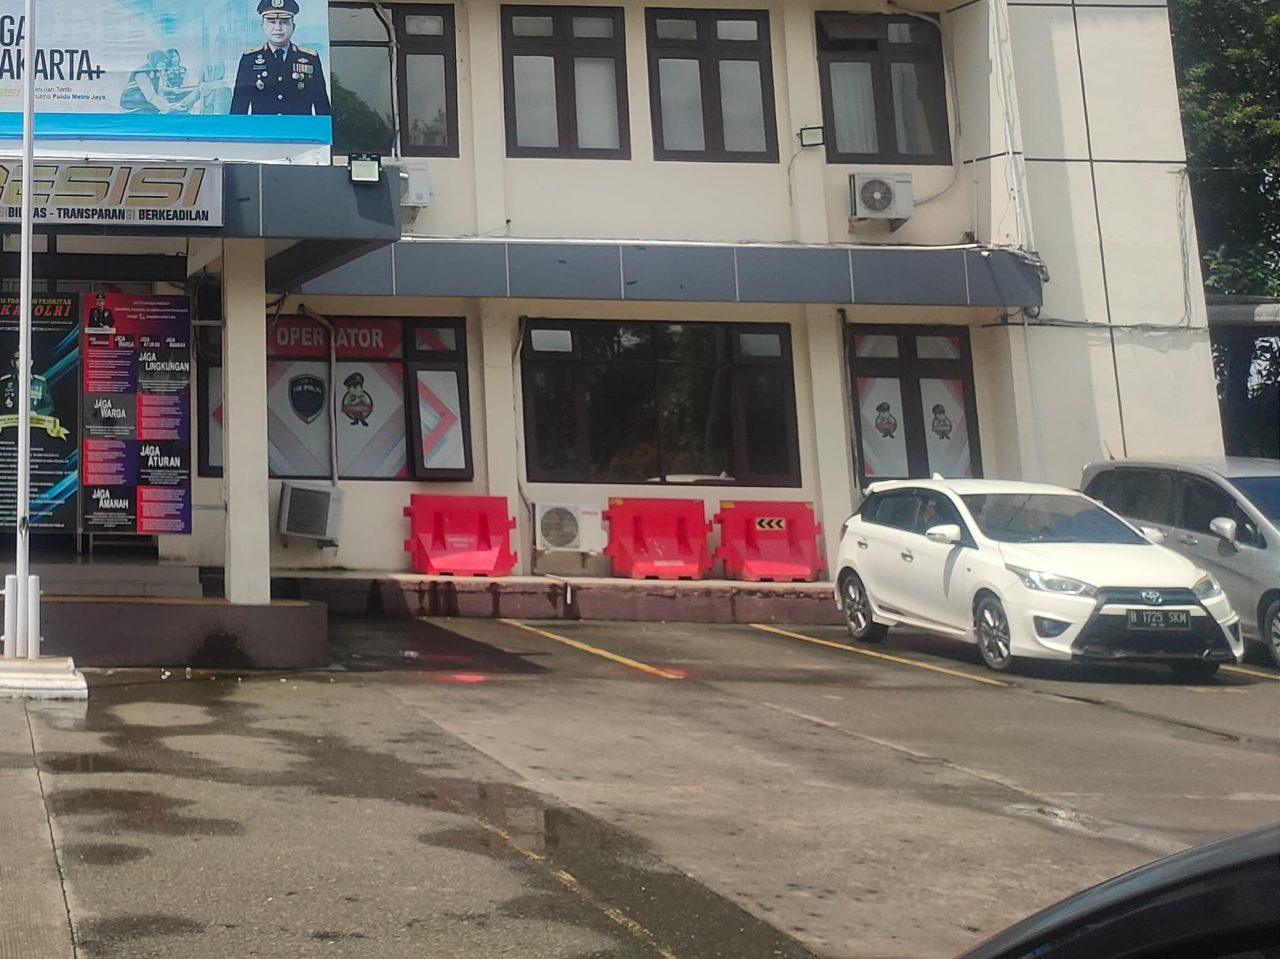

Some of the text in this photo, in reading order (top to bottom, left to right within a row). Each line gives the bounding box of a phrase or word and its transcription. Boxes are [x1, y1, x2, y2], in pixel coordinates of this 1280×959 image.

[91, 93, 106, 101] Jaya
[57, 207, 135, 221] TRANSPARANSI
[138, 209, 209, 222] BERKEADILAN
[0, 304, 73, 317] KAOLRI
[277, 327, 384, 348] OPERATOR
[138, 352, 157, 361] JAGA
[145, 362, 190, 371] LINGKUNGAN
[94, 400, 112, 409] JAGA
[100, 409, 127, 418] WARGA
[140, 445, 161, 456] JAGA
[147, 457, 180, 467] ATURAN
[91, 489, 111, 499] JAGA
[98, 499, 129, 509] AMANAH
